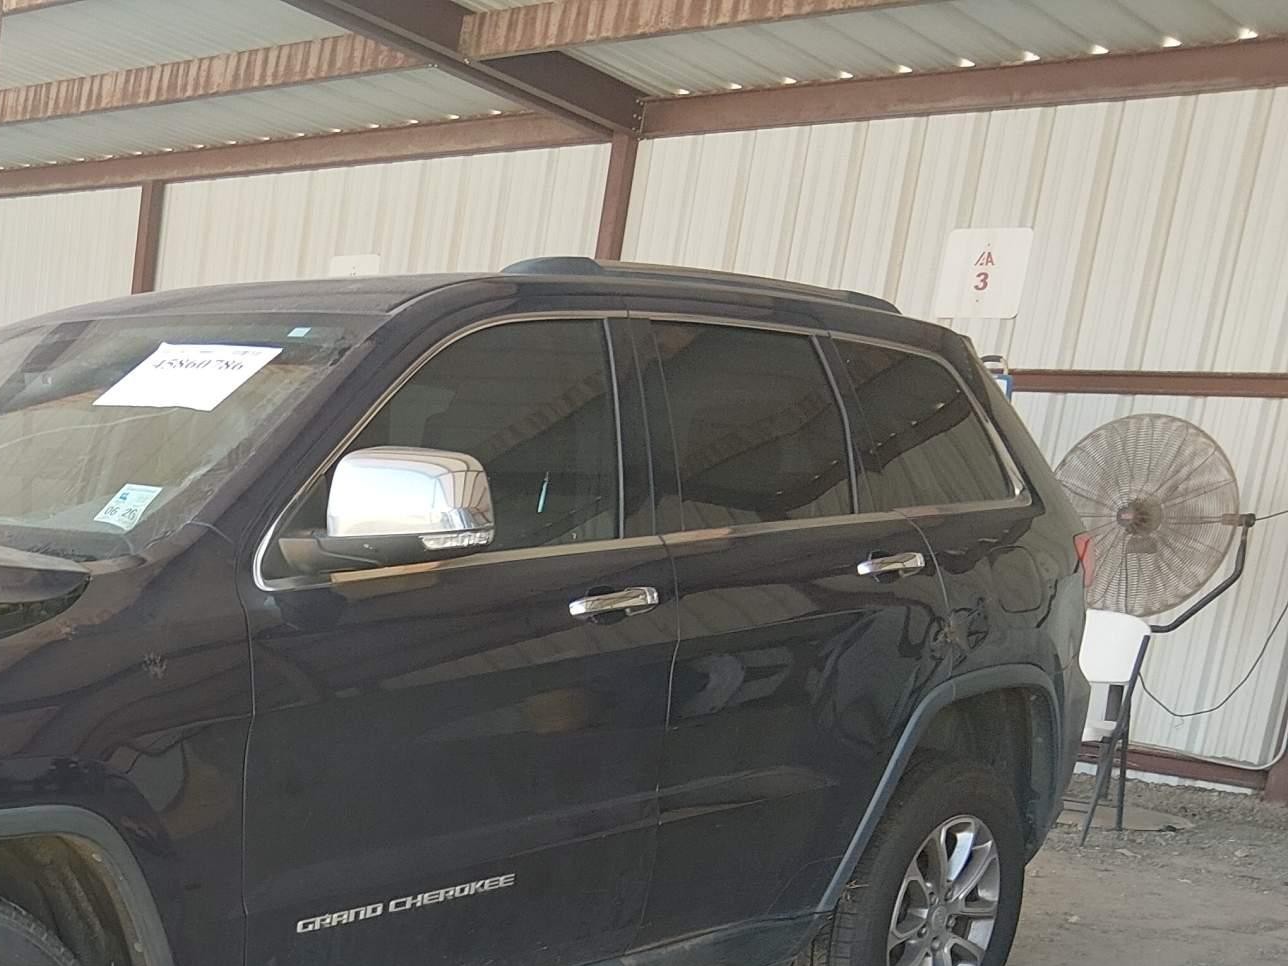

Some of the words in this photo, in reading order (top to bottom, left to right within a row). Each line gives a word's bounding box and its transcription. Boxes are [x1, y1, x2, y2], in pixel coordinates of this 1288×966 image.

[974, 272, 989, 291] 3
[152, 358, 245, 371] 45860786
[296, 903, 383, 933] GRAND
[388, 873, 516, 914] CHEROKEE
